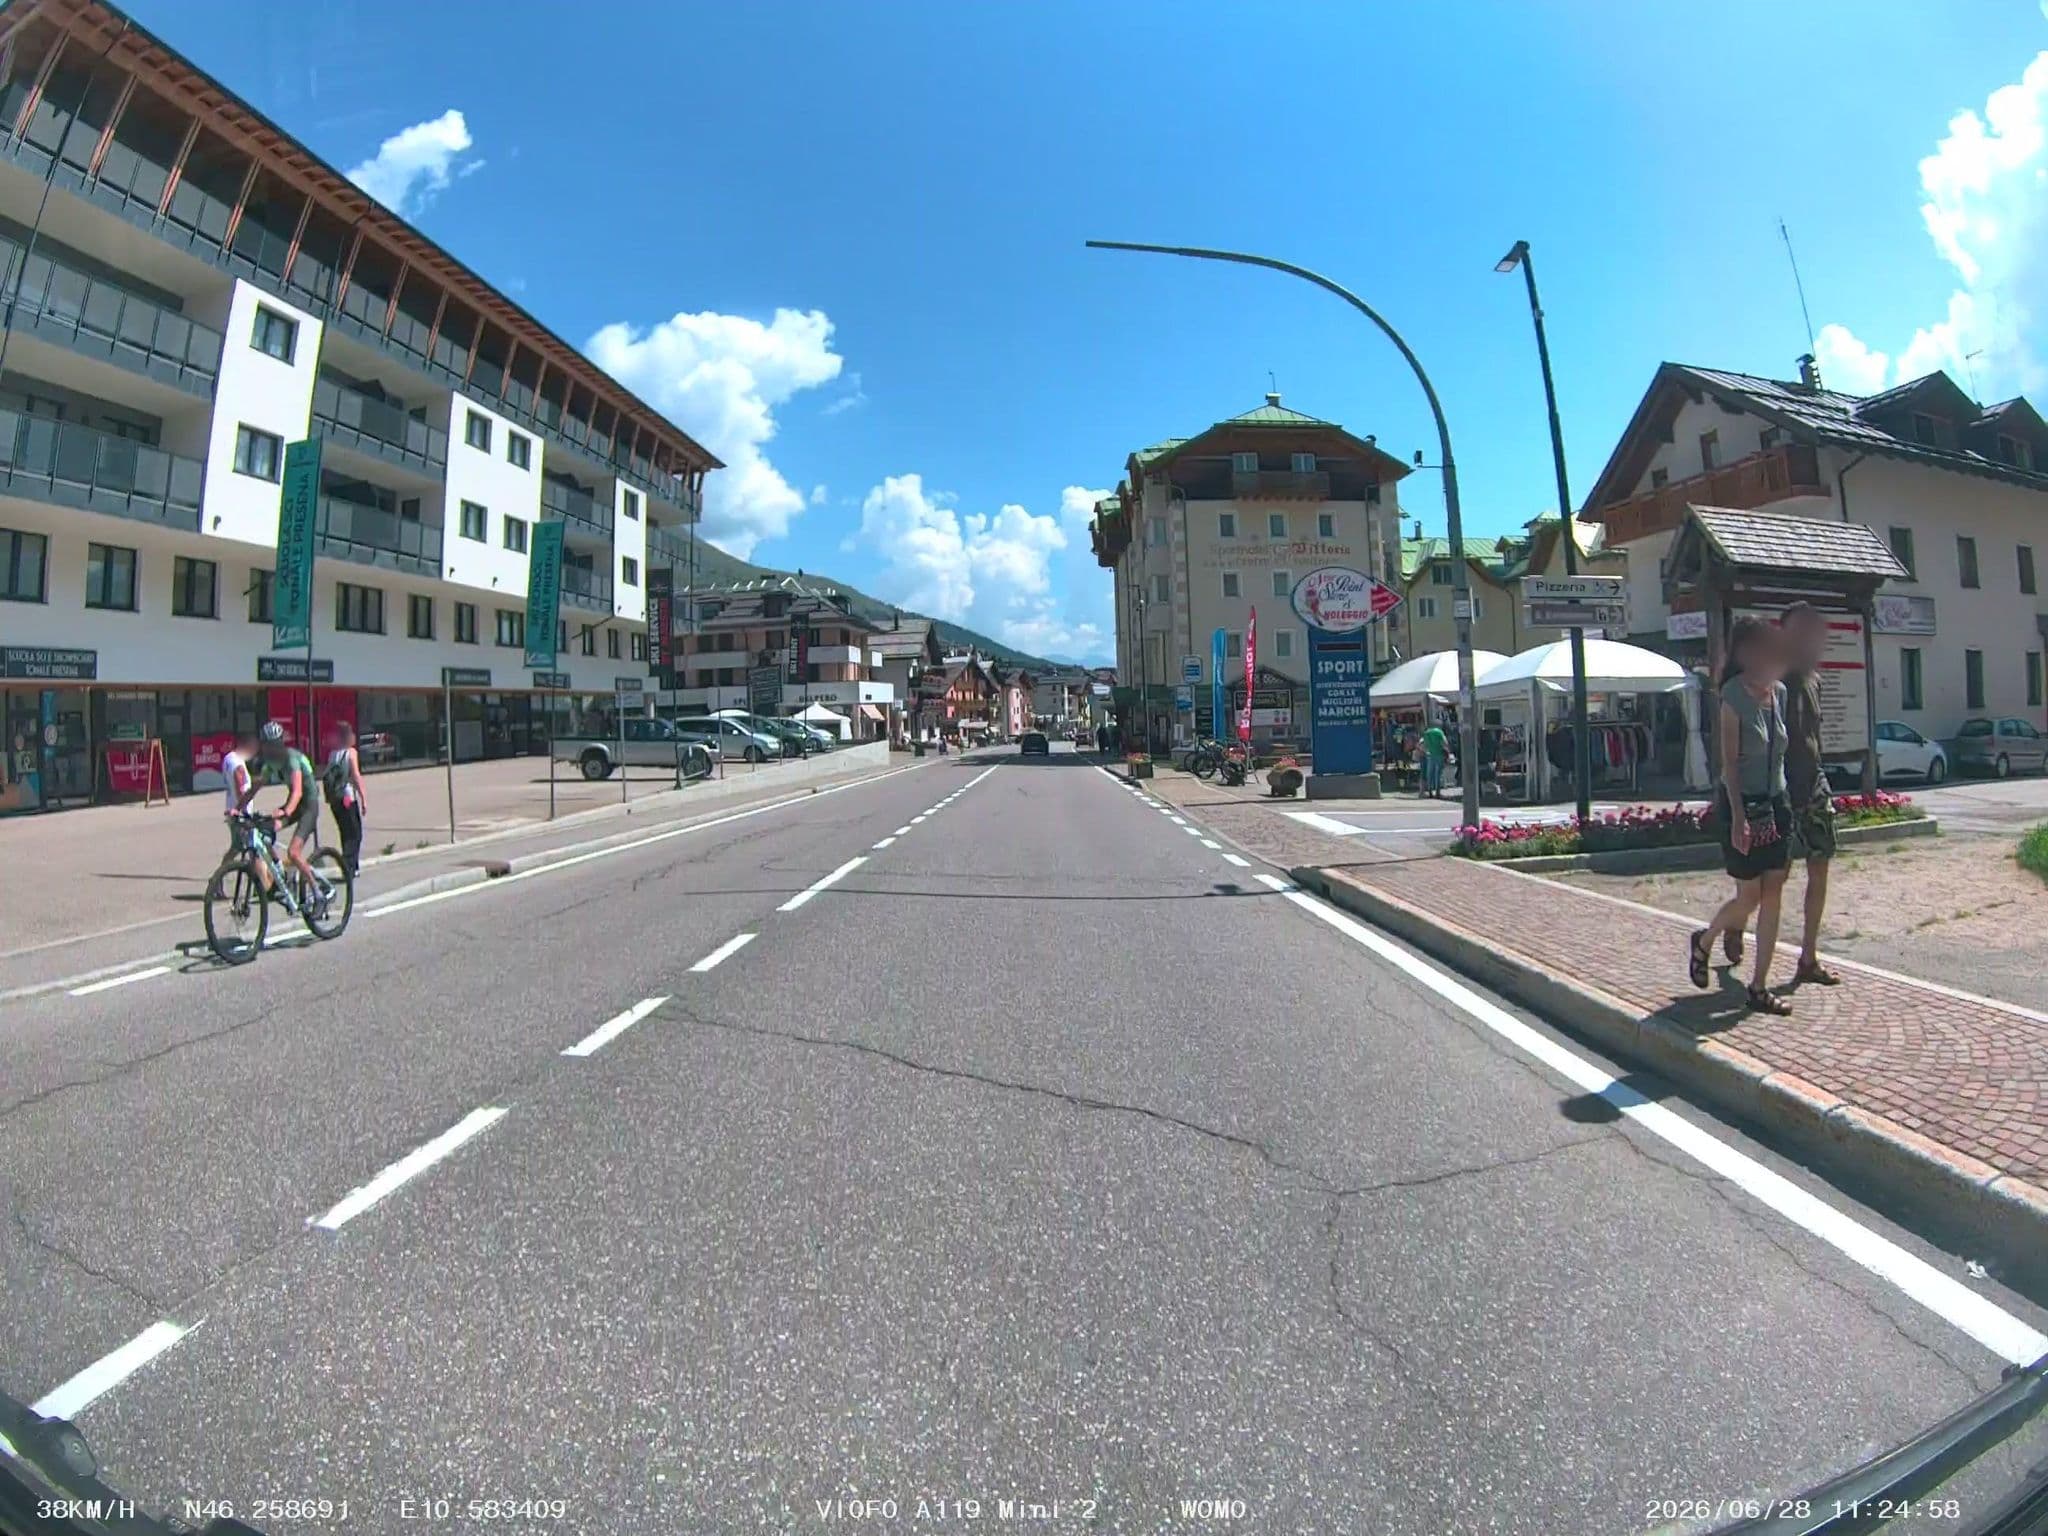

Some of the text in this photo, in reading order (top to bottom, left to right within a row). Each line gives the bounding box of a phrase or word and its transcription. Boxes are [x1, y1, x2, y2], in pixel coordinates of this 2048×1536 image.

[292, 473, 310, 543] PRESENA
[280, 524, 292, 588] SCUOLA
[289, 547, 303, 613] TONALE
[1336, 575, 1365, 592] Point
[1536, 581, 1586, 592] Pizzeria
[1323, 610, 1369, 620] NOLEGGIO
[650, 646, 660, 665] SKI
[1317, 660, 1365, 674] SPORT
[1318, 706, 1367, 717] MARCHE
